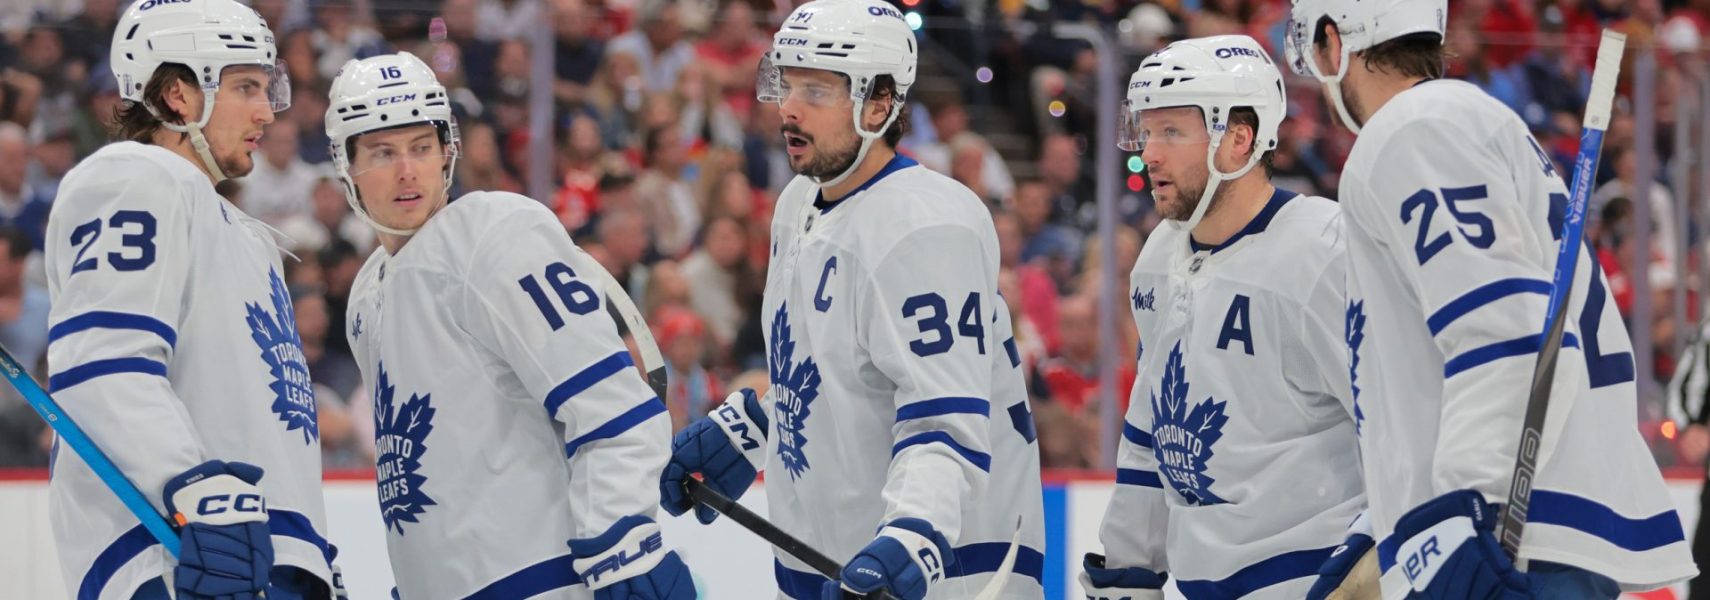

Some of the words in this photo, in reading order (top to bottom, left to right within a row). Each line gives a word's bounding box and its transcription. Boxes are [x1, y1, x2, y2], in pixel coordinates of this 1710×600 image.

[778, 37, 809, 46] CCM
[1215, 47, 1260, 59] OREO
[379, 66, 402, 80] 16
[1130, 81, 1152, 89] CCM
[376, 94, 417, 106] CCM
[1400, 184, 1496, 266] 25
[70, 210, 158, 275] 23
[518, 261, 600, 332] 16
[813, 256, 838, 312] C
[1132, 286, 1156, 312] Milk
[901, 291, 986, 357] 34
[1216, 294, 1255, 356] A
[719, 402, 760, 451] CM
[1154, 424, 1203, 457] TORONTO
[1162, 448, 1195, 470] MAPLE
[379, 478, 409, 503] LEAFS
[197, 493, 266, 516] CC
[580, 531, 662, 588] TRUE
[856, 567, 882, 579] CCM
